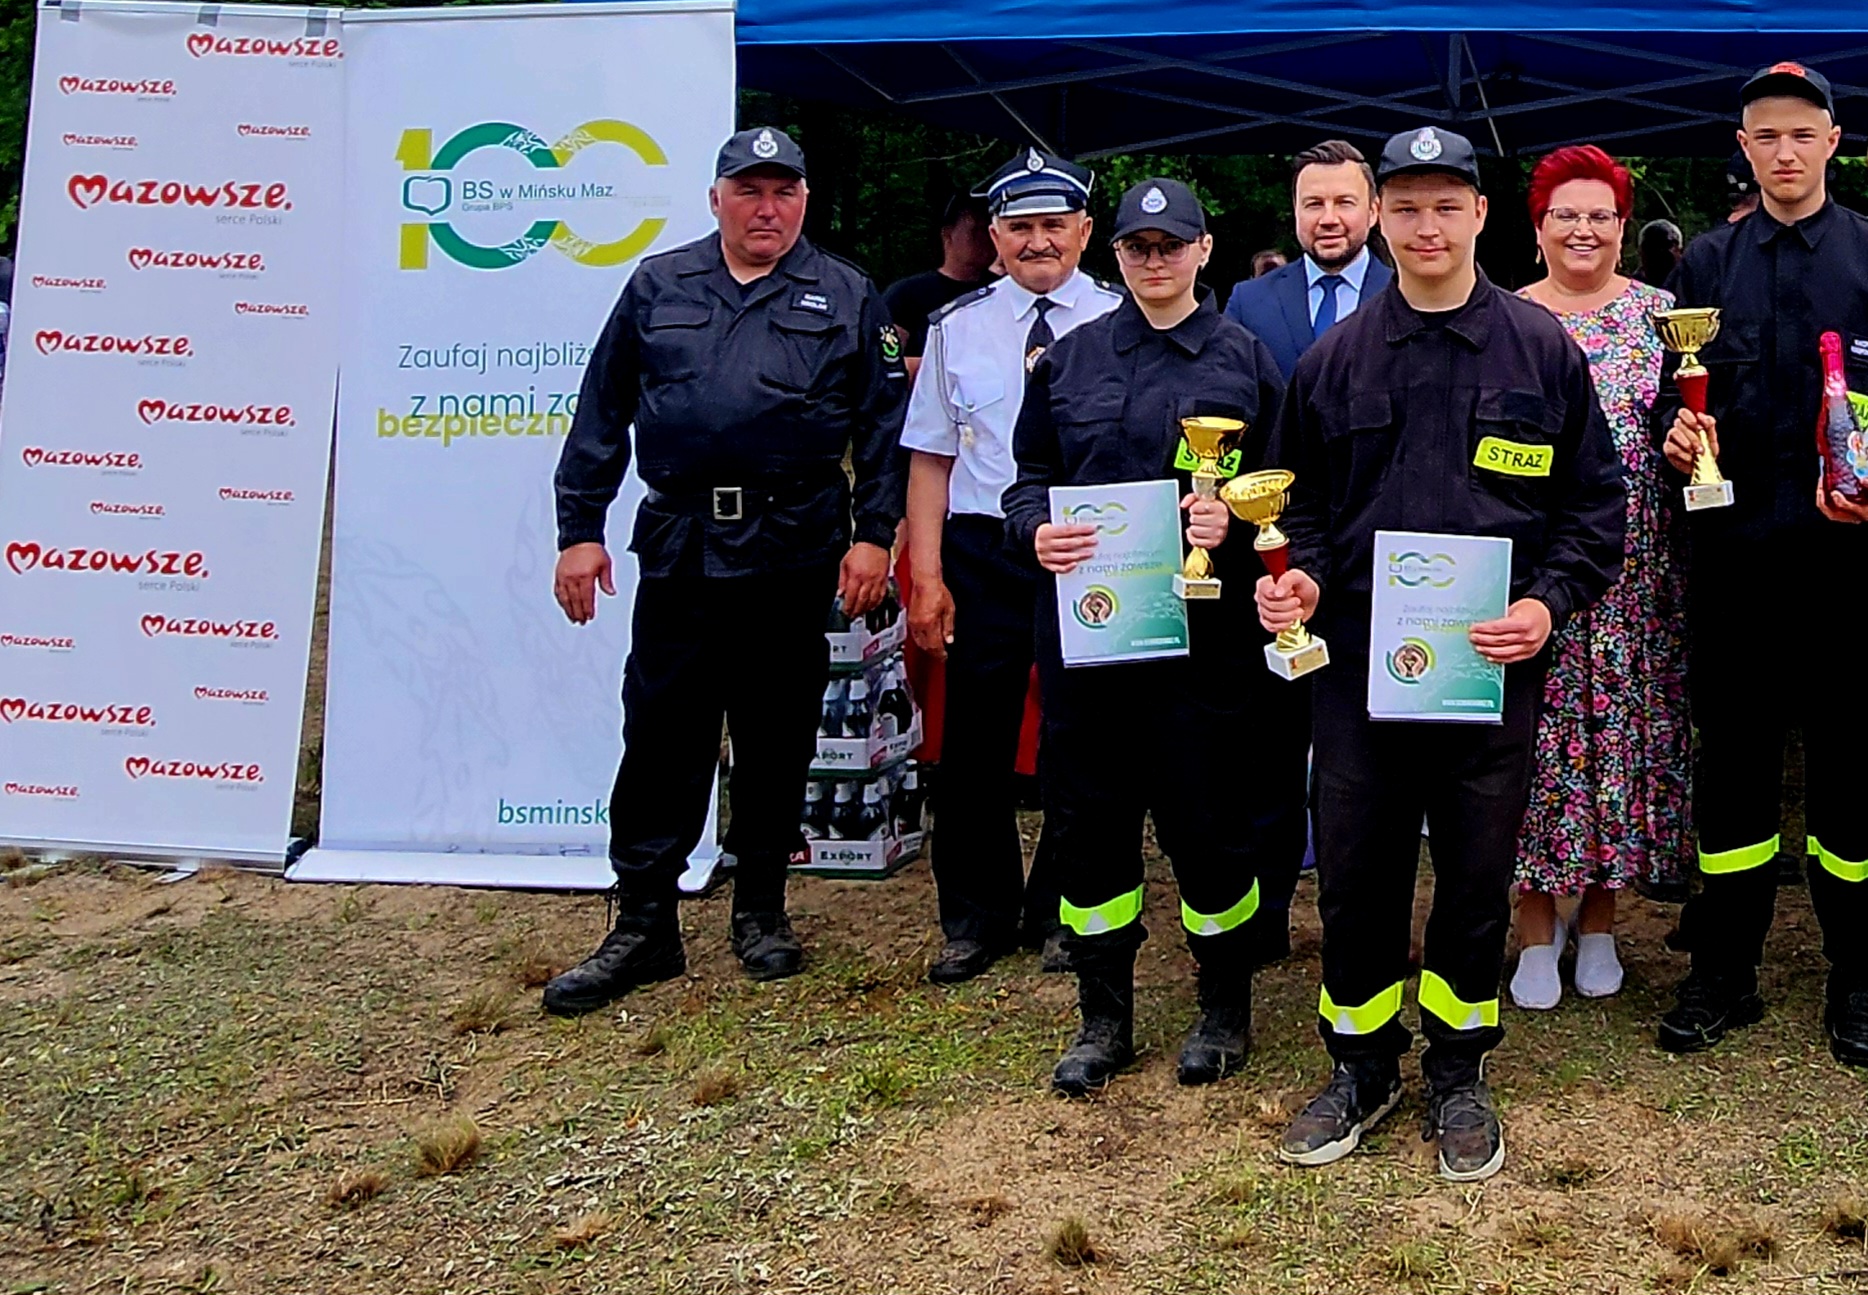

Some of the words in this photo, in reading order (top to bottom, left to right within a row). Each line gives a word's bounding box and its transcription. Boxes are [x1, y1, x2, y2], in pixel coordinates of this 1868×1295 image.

[187, 33, 344, 58] Mazowsze.
[60, 77, 176, 95] Mazowsze.
[68, 175, 293, 210] Mazowsze.
[462, 181, 493, 200] BS
[500, 187, 513, 199] w
[519, 182, 576, 199] Mińsku
[215, 214, 245, 225] serce
[249, 214, 282, 226] Polski
[129, 249, 266, 271] Mazowsze.
[36, 331, 194, 356] Mazowsze.
[399, 342, 487, 375] Zaufaj
[138, 400, 295, 426] Mazowsze.
[410, 395, 427, 418] z
[440, 386, 535, 418] nami
[24, 448, 143, 468] Mazowsze.
[7, 542, 209, 578] Mazowsze.
[141, 615, 279, 639] Mazowsze.
[0, 698, 156, 726] Mazowsze.
[126, 757, 264, 782] Mazowsze.
[498, 798, 608, 824] bsminsk
